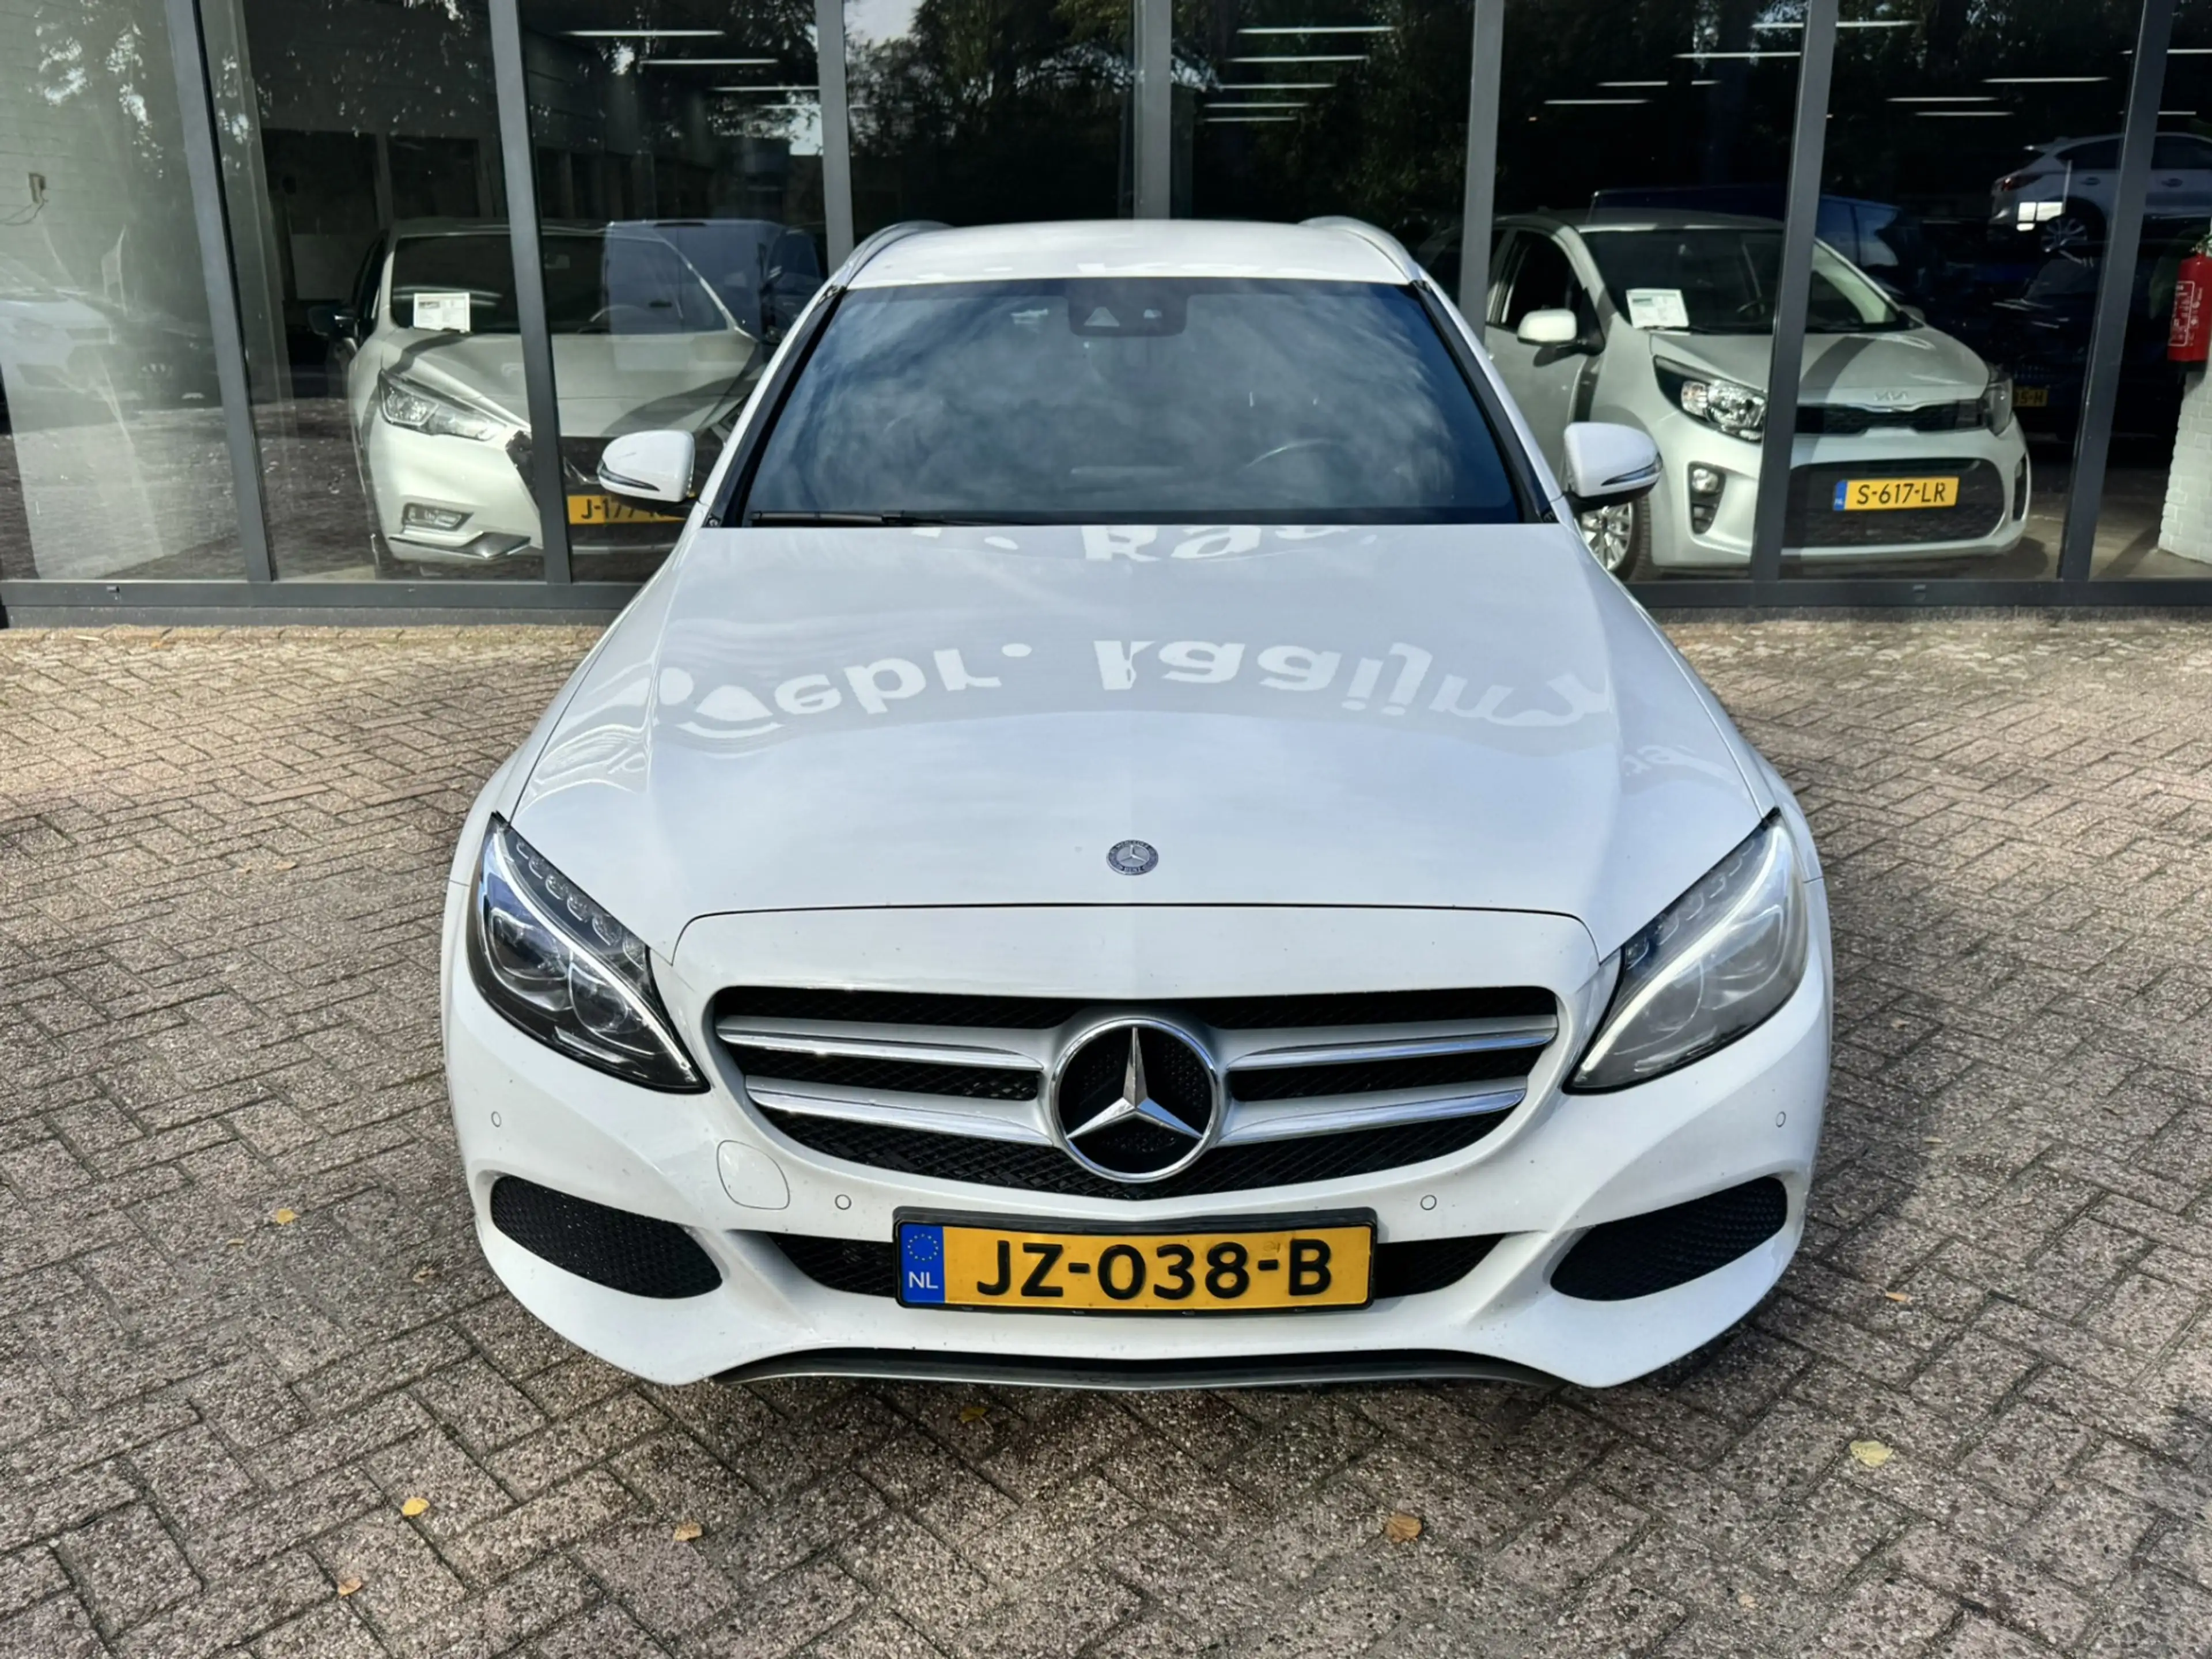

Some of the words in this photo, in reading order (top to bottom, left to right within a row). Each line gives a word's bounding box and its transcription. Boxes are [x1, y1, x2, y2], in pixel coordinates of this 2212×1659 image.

[1857, 482, 1946, 505] S-617-LR
[909, 1271, 939, 1289] NL
[976, 1238, 1332, 1301] JZ-038-B
